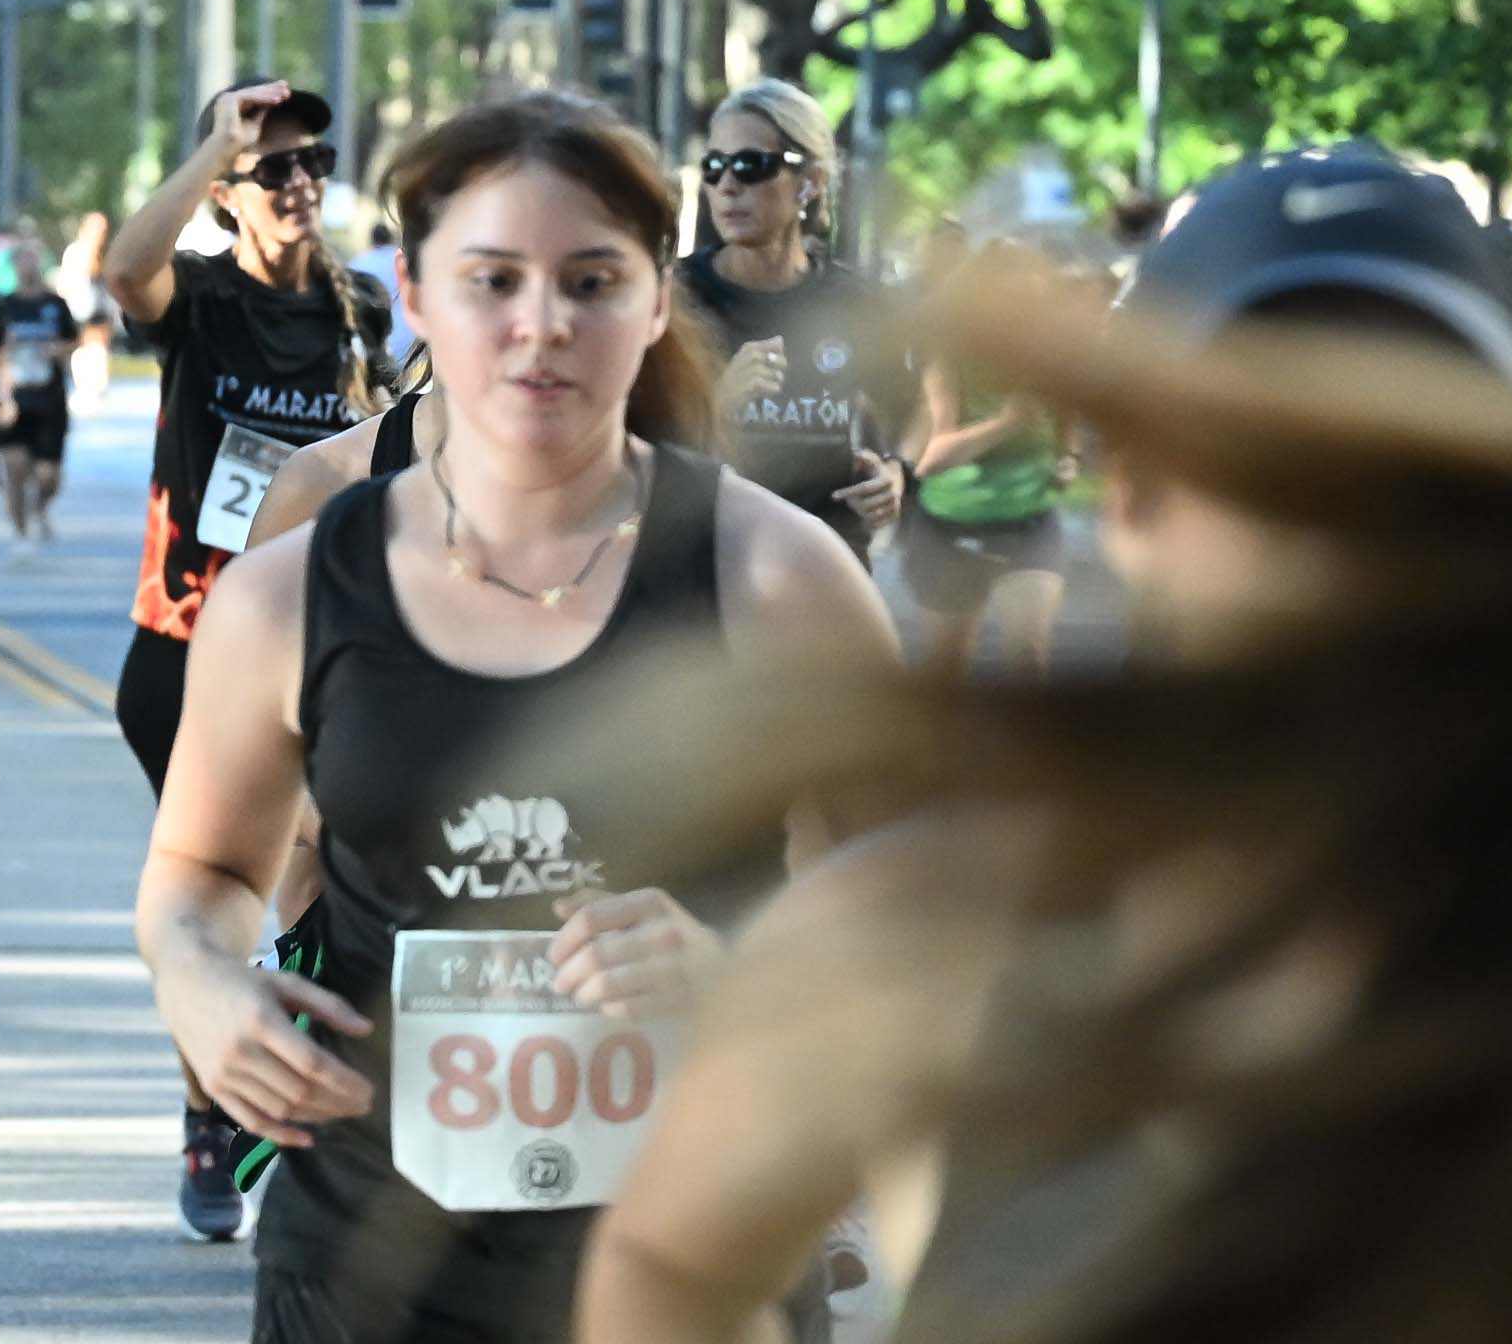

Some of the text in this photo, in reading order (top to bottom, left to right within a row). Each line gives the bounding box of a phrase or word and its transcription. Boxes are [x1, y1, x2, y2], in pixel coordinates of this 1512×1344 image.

[741, 387, 849, 427] ARATÓN
[221, 473, 267, 518] 2
[425, 861, 605, 898] VLACK
[429, 1033, 655, 1131] 800
